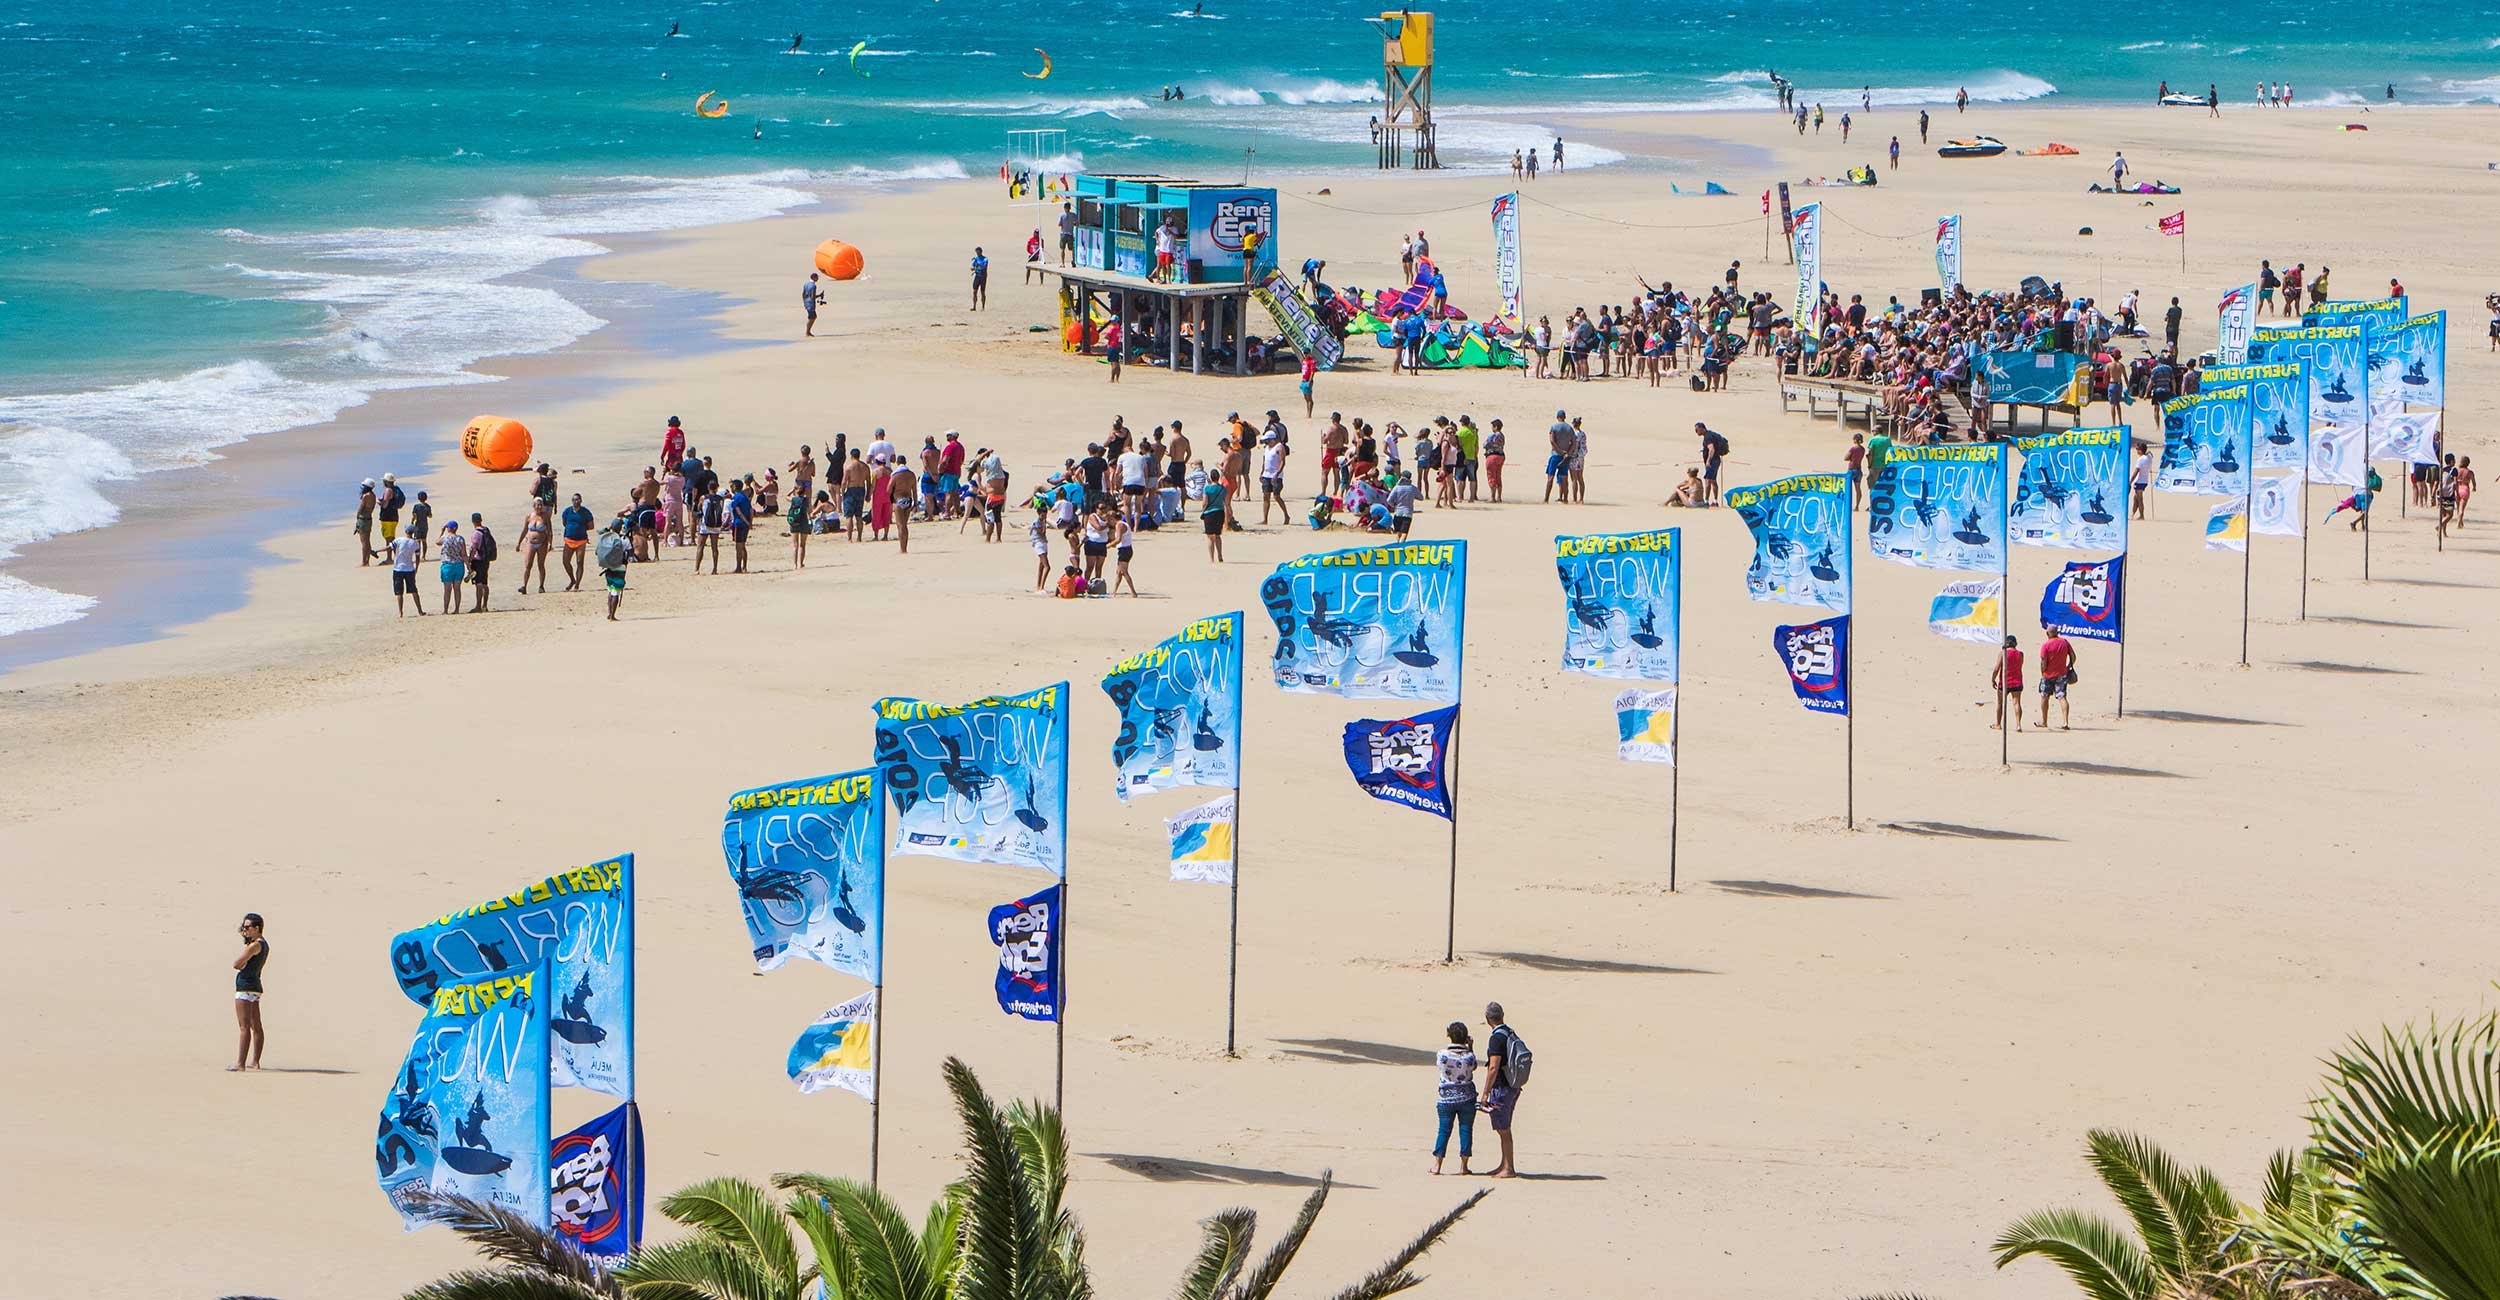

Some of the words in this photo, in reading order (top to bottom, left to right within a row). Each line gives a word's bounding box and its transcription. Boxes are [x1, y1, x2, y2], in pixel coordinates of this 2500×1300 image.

[1217, 201, 1271, 217] René
[1257, 290, 1308, 350] FUERTEVENTUR
[1266, 276, 1322, 343] René
[470, 427, 480, 459] Egli
